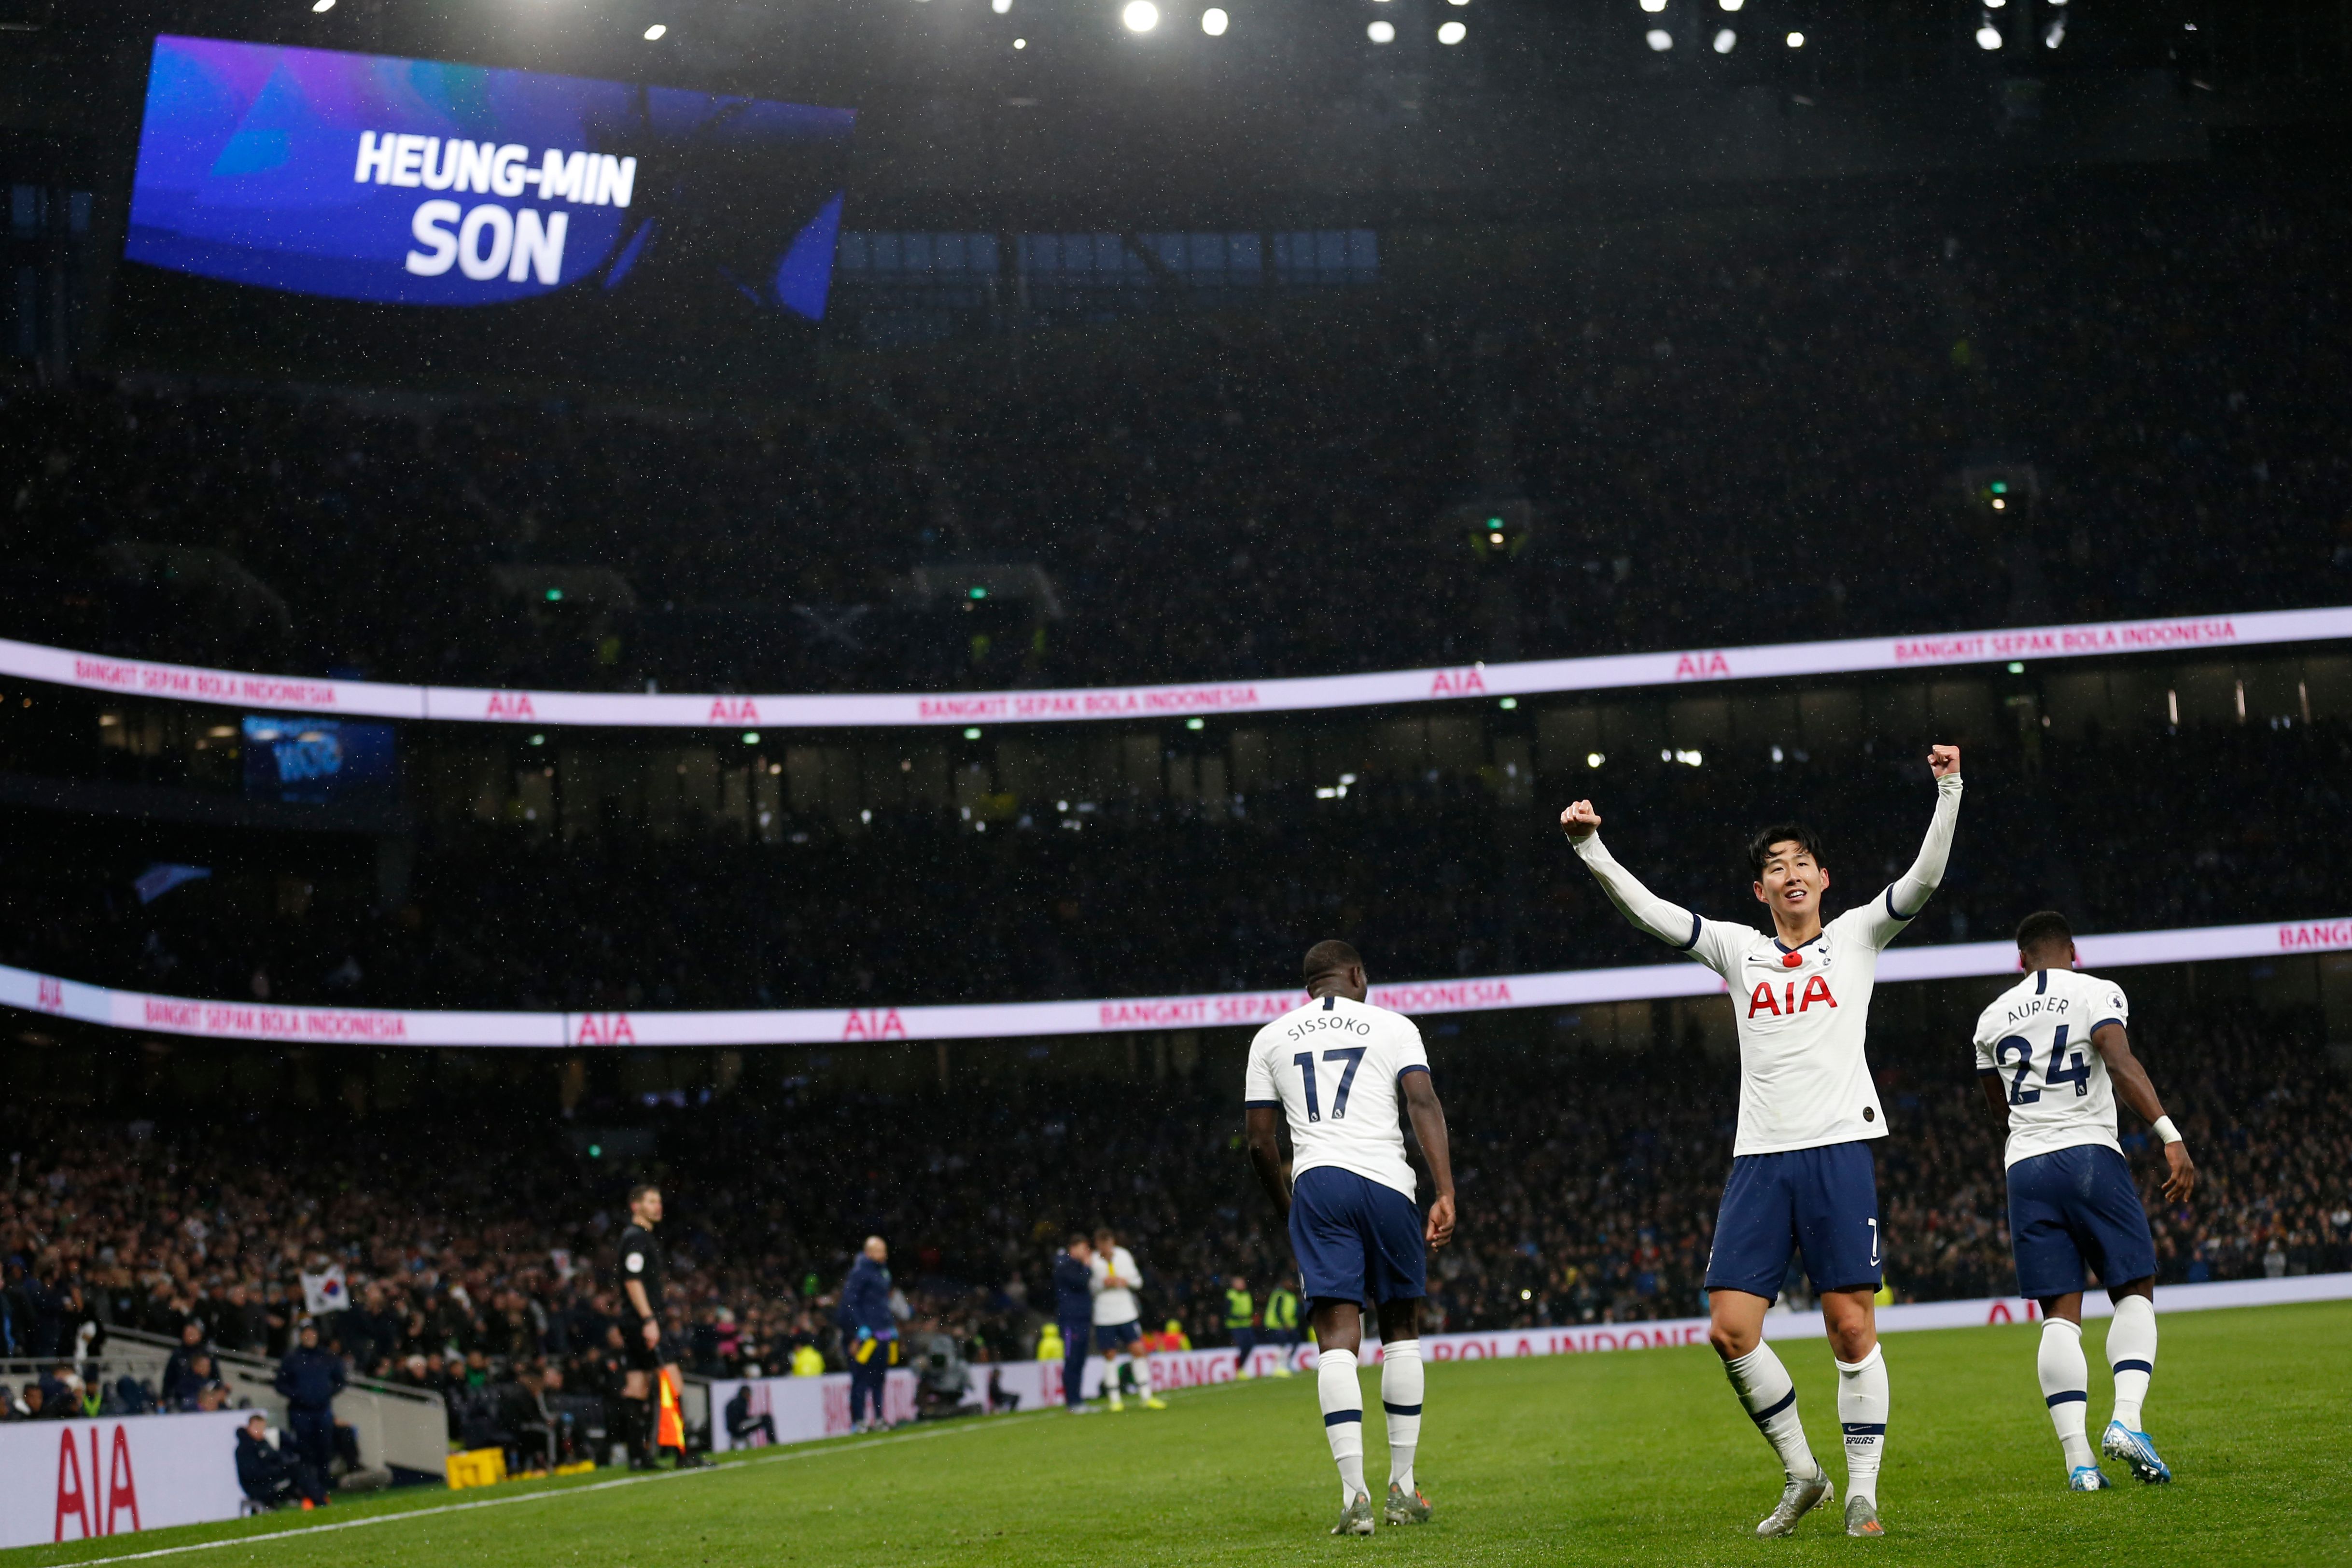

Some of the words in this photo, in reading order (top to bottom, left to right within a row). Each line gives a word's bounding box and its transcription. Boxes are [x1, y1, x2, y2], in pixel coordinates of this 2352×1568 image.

[354, 129, 637, 208] HEUNG-MIN
[406, 197, 569, 286] SON
[1894, 635, 1985, 663] BANGKIT
[1992, 632, 2056, 656] SEPAK
[2061, 628, 2117, 650] BOLA
[2123, 620, 2237, 645] INDONESIA
[1675, 650, 1730, 679] AIA
[1431, 668, 1486, 696] AIA
[486, 692, 535, 720] AIA
[709, 696, 761, 725] AIA
[1084, 692, 1139, 713] BOLA
[1144, 686, 1259, 710] INDONESIA
[2279, 920, 2352, 953] BANG
[1099, 998, 1207, 1028] BANGKIT
[1215, 994, 1292, 1022] SEPAK
[1747, 975, 1838, 1020] AIA
[2007, 996, 2069, 1026] AURIER
[577, 1012, 637, 1046] AIA
[842, 1007, 908, 1042] AIA
[1287, 1016, 1371, 1042] SISSOKO
[1996, 1024, 2091, 1106] 24
[1293, 1046, 1368, 1123] 17
[1867, 1217, 1878, 1258] 7
[1846, 1436, 1876, 1446] SPURS
[54, 1424, 141, 1543] AIA
